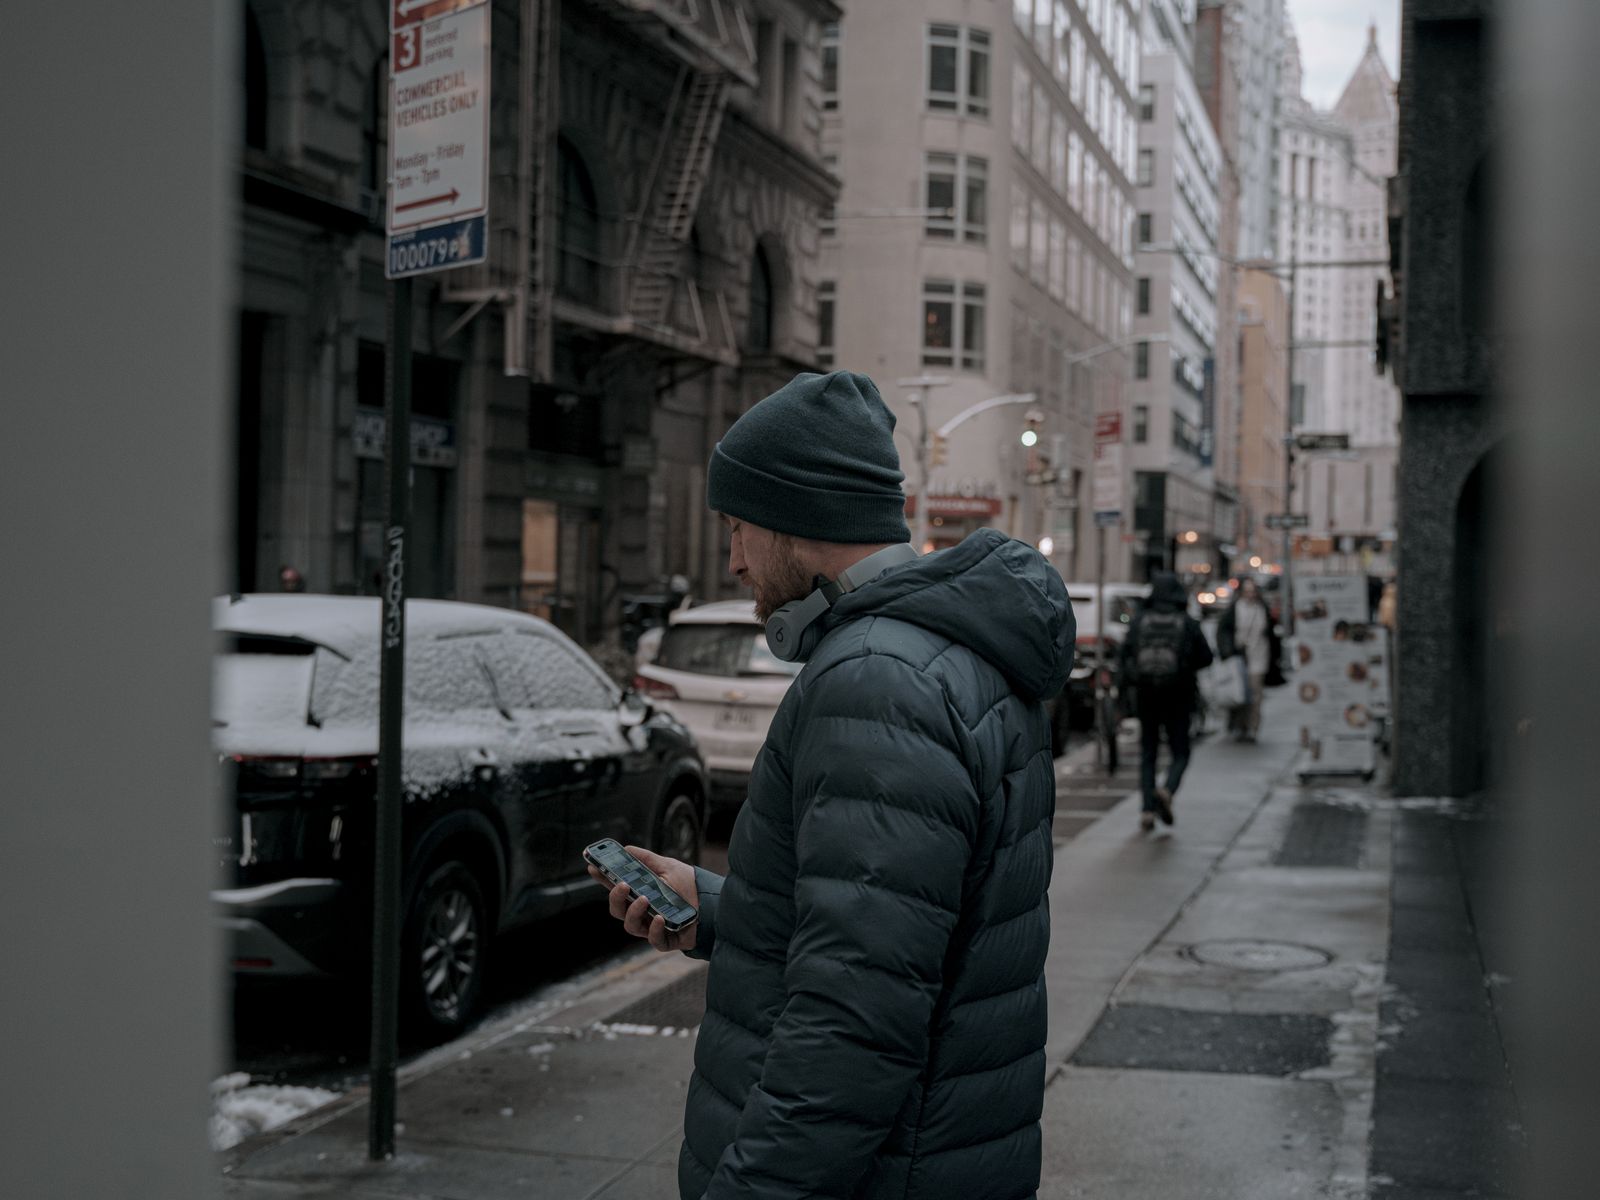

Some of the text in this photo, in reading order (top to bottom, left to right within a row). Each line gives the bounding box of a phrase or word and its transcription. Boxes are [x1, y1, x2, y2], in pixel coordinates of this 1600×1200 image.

[398, 28, 416, 67] 3
[424, 47, 454, 66] parking
[397, 70, 466, 106] COMMERCIAL
[396, 89, 479, 128] VEHICLES ONLY
[395, 152, 428, 170] Monday
[437, 143, 465, 160] Friday
[421, 168, 440, 185] 7pm
[391, 237, 448, 272] 100079
